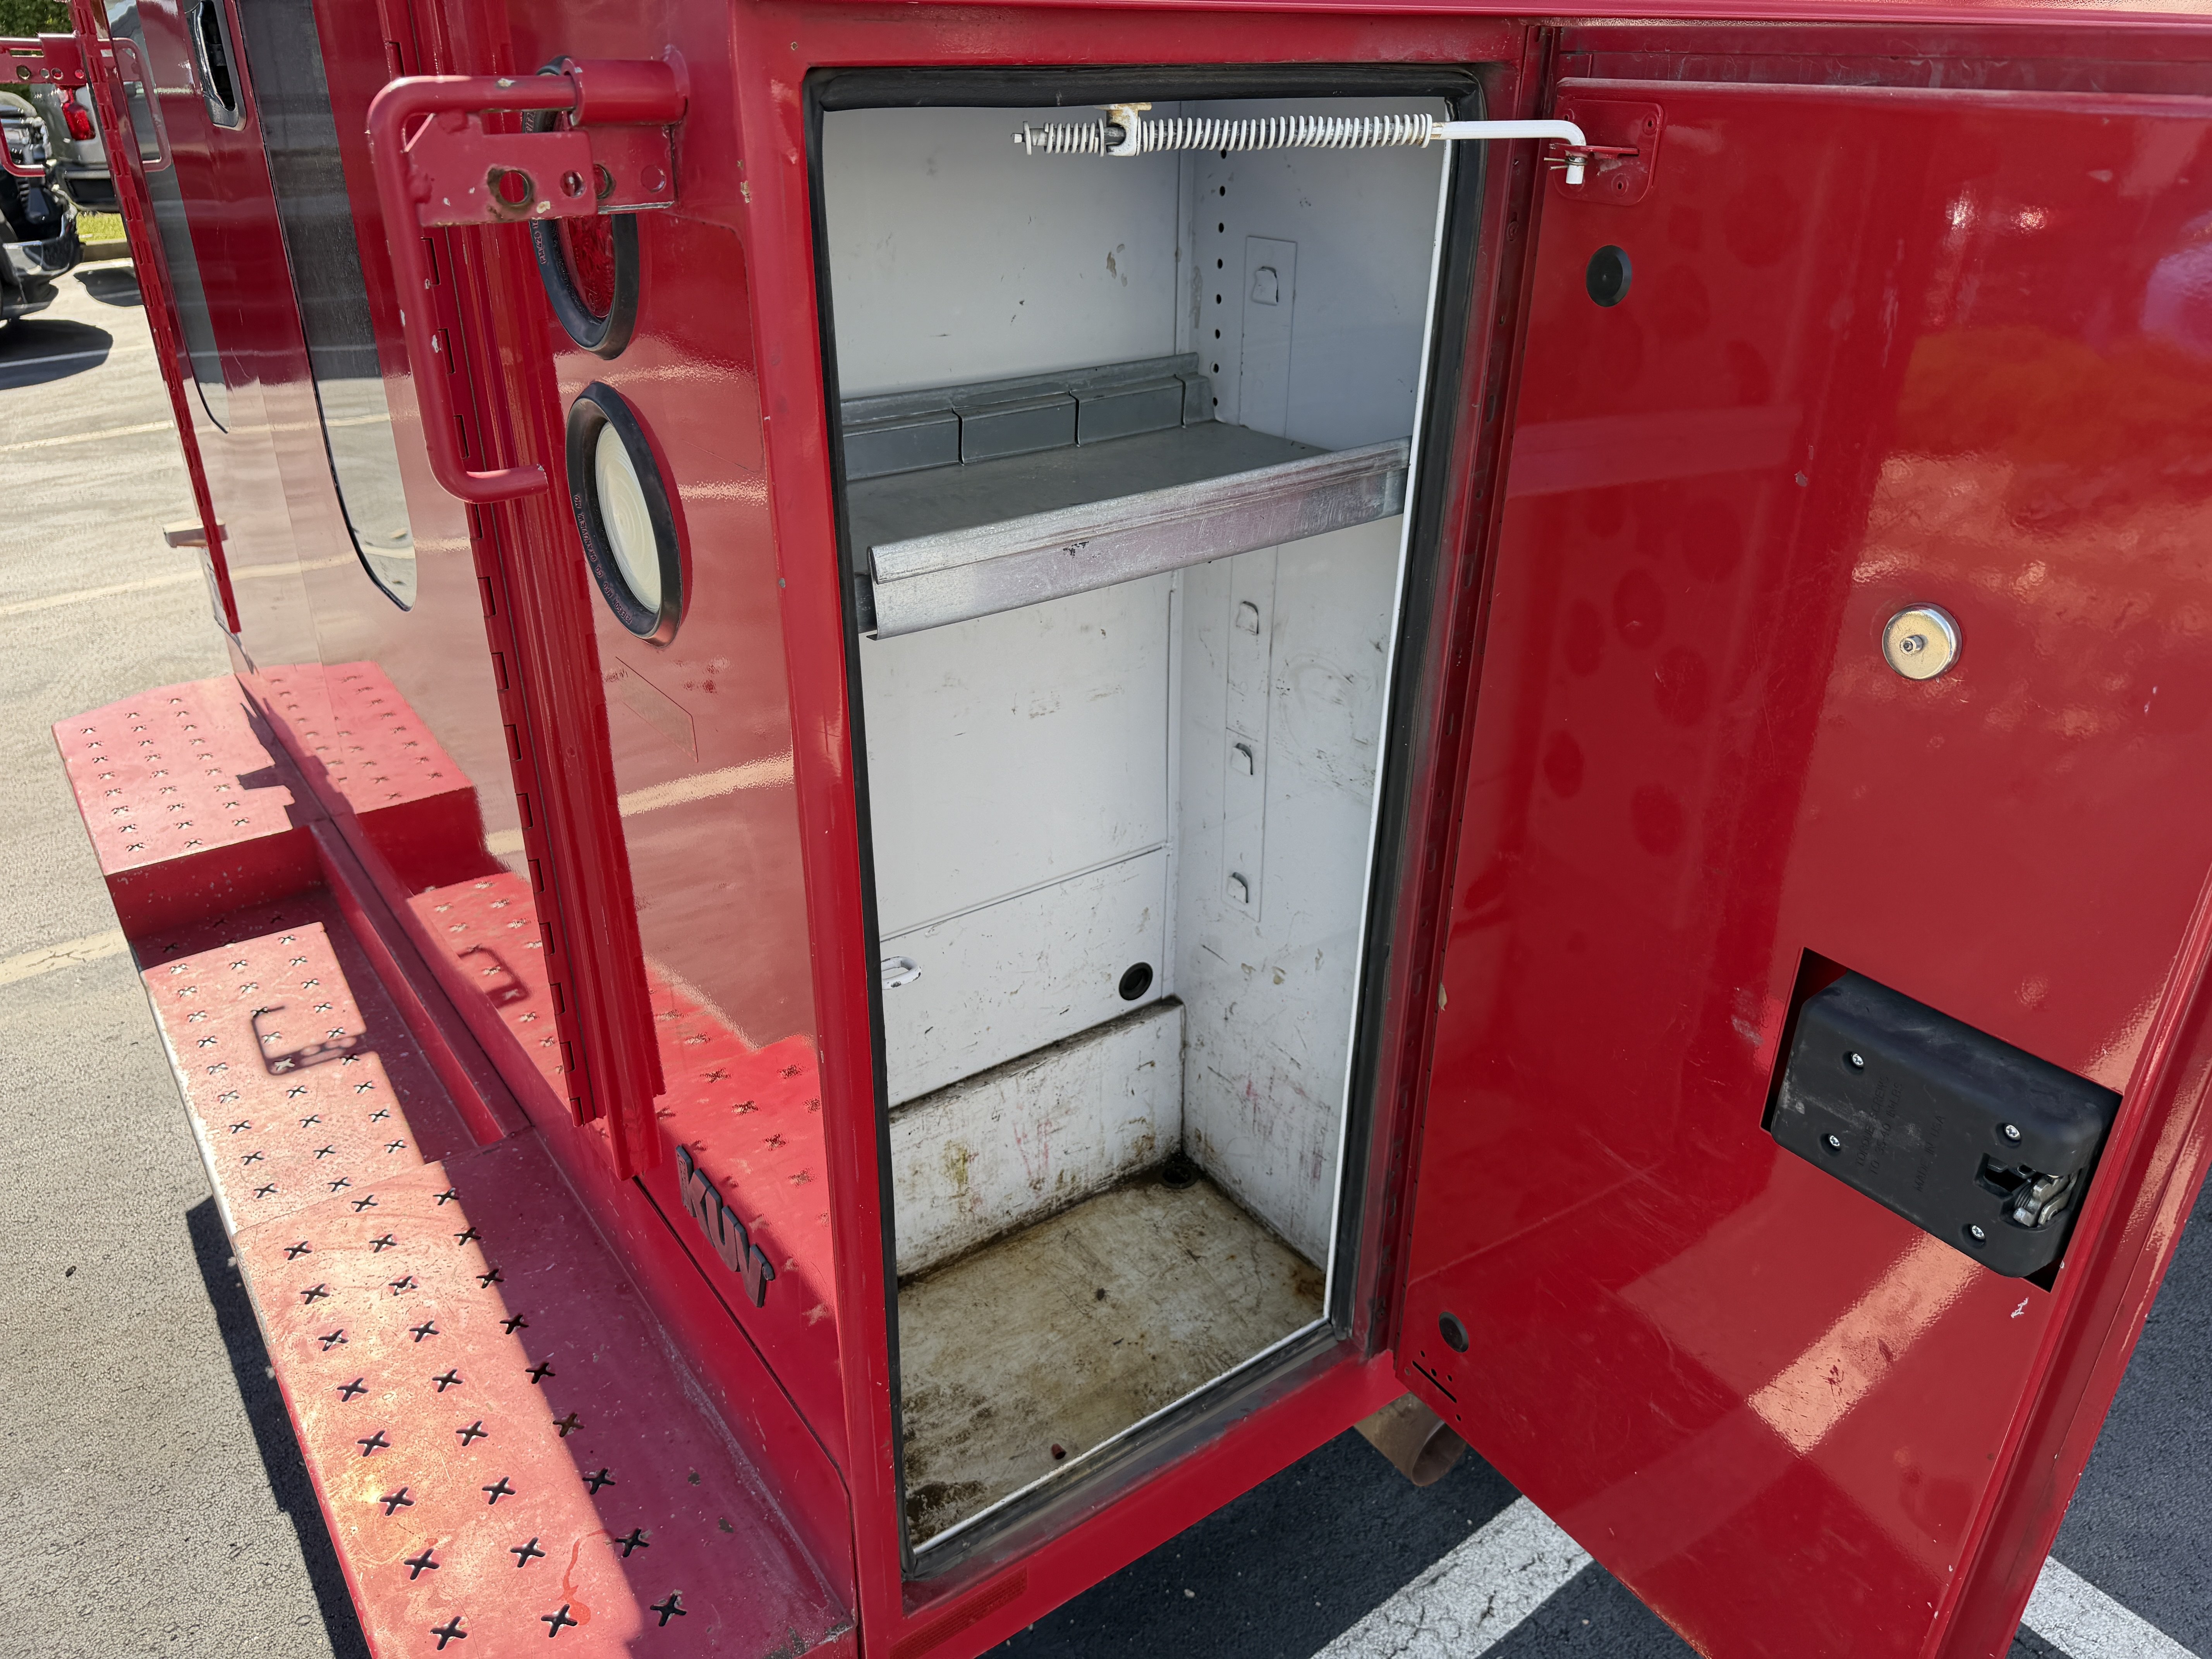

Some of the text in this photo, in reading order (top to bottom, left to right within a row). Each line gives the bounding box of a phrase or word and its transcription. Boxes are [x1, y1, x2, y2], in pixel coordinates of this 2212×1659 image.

[1856, 1122, 1875, 1166] TORQUE
[1870, 1160, 1880, 1175] TO
[1913, 1115, 1947, 1193] MADE IN USA
[676, 1145, 768, 1308] KUV
